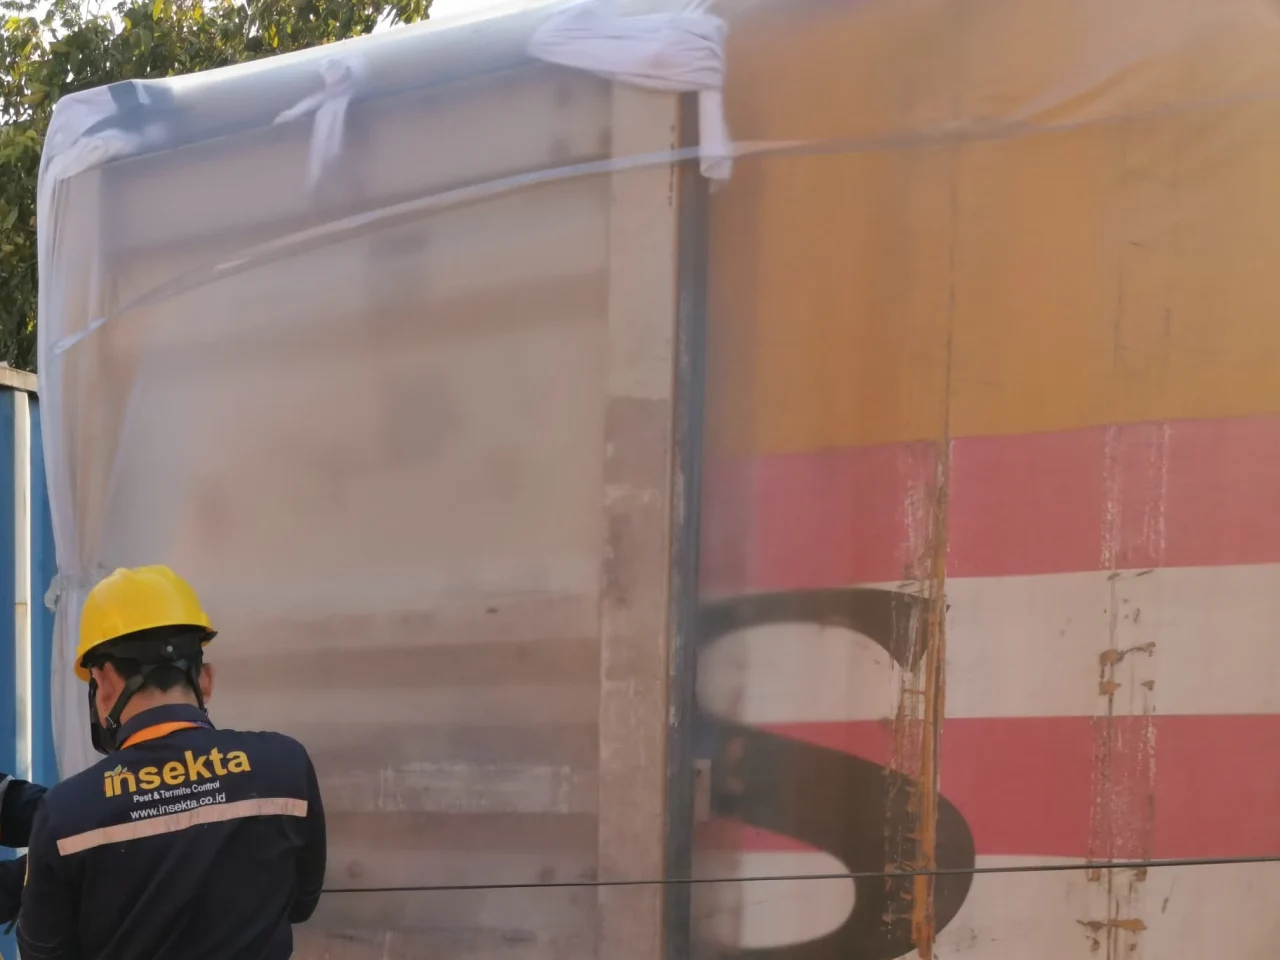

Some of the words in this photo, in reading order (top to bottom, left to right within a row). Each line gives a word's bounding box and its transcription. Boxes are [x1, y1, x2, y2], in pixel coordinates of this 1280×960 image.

[104, 747, 251, 797] insekta
[133, 794, 152, 803] Pest
[153, 791, 160, 800] &
[160, 787, 191, 799] Termite
[192, 780, 220, 793] Control
[130, 793, 226, 820] www.insekta.co.id
